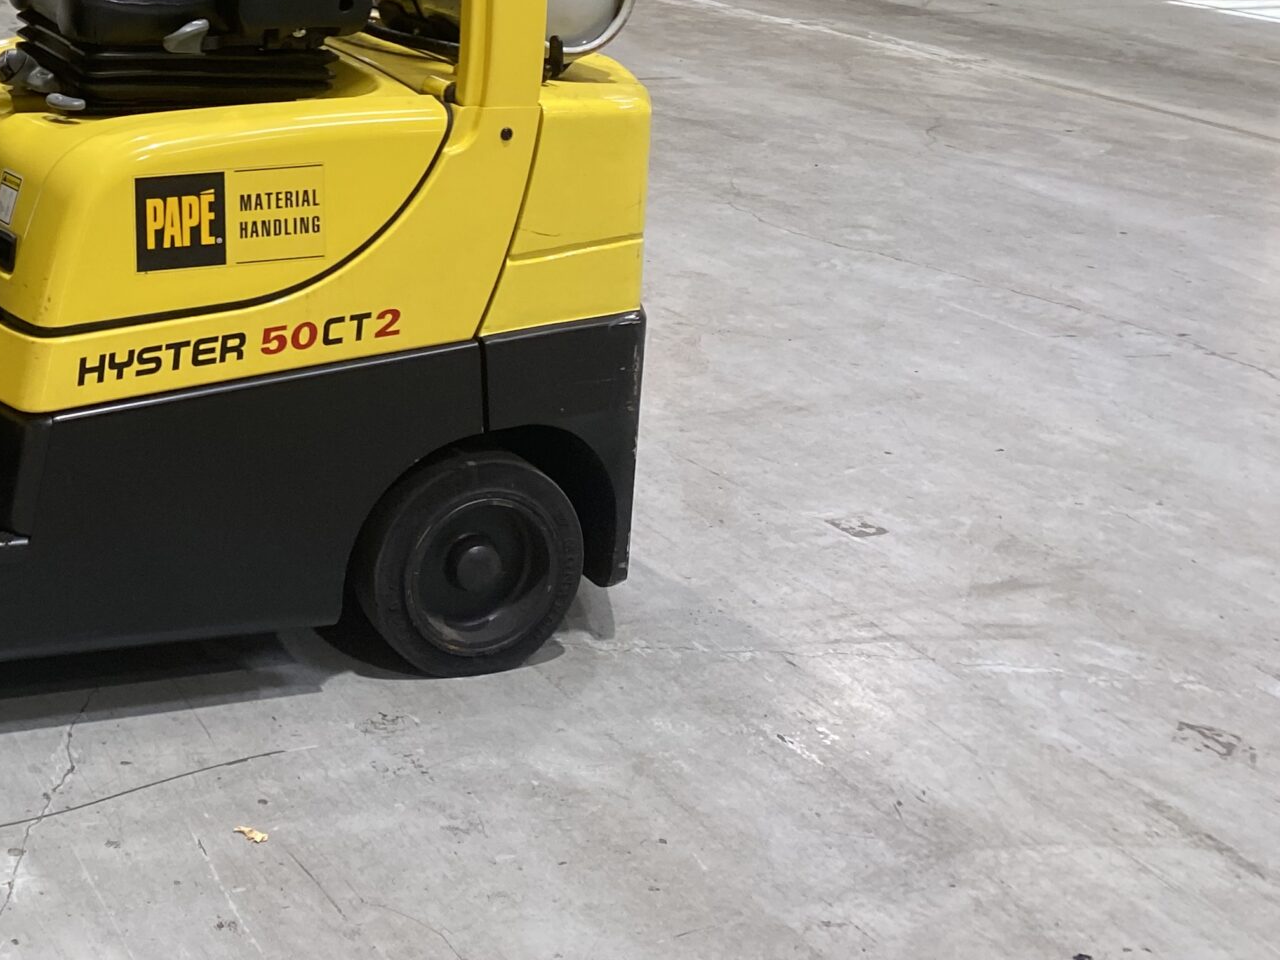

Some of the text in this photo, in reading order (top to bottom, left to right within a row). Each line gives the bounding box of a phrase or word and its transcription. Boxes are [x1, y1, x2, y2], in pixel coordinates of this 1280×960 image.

[144, 189, 216, 250] PAPÉ
[239, 189, 320, 212] MATERIAL
[239, 215, 321, 239] HANDLING
[77, 308, 402, 386] HYSTER 50CT2
